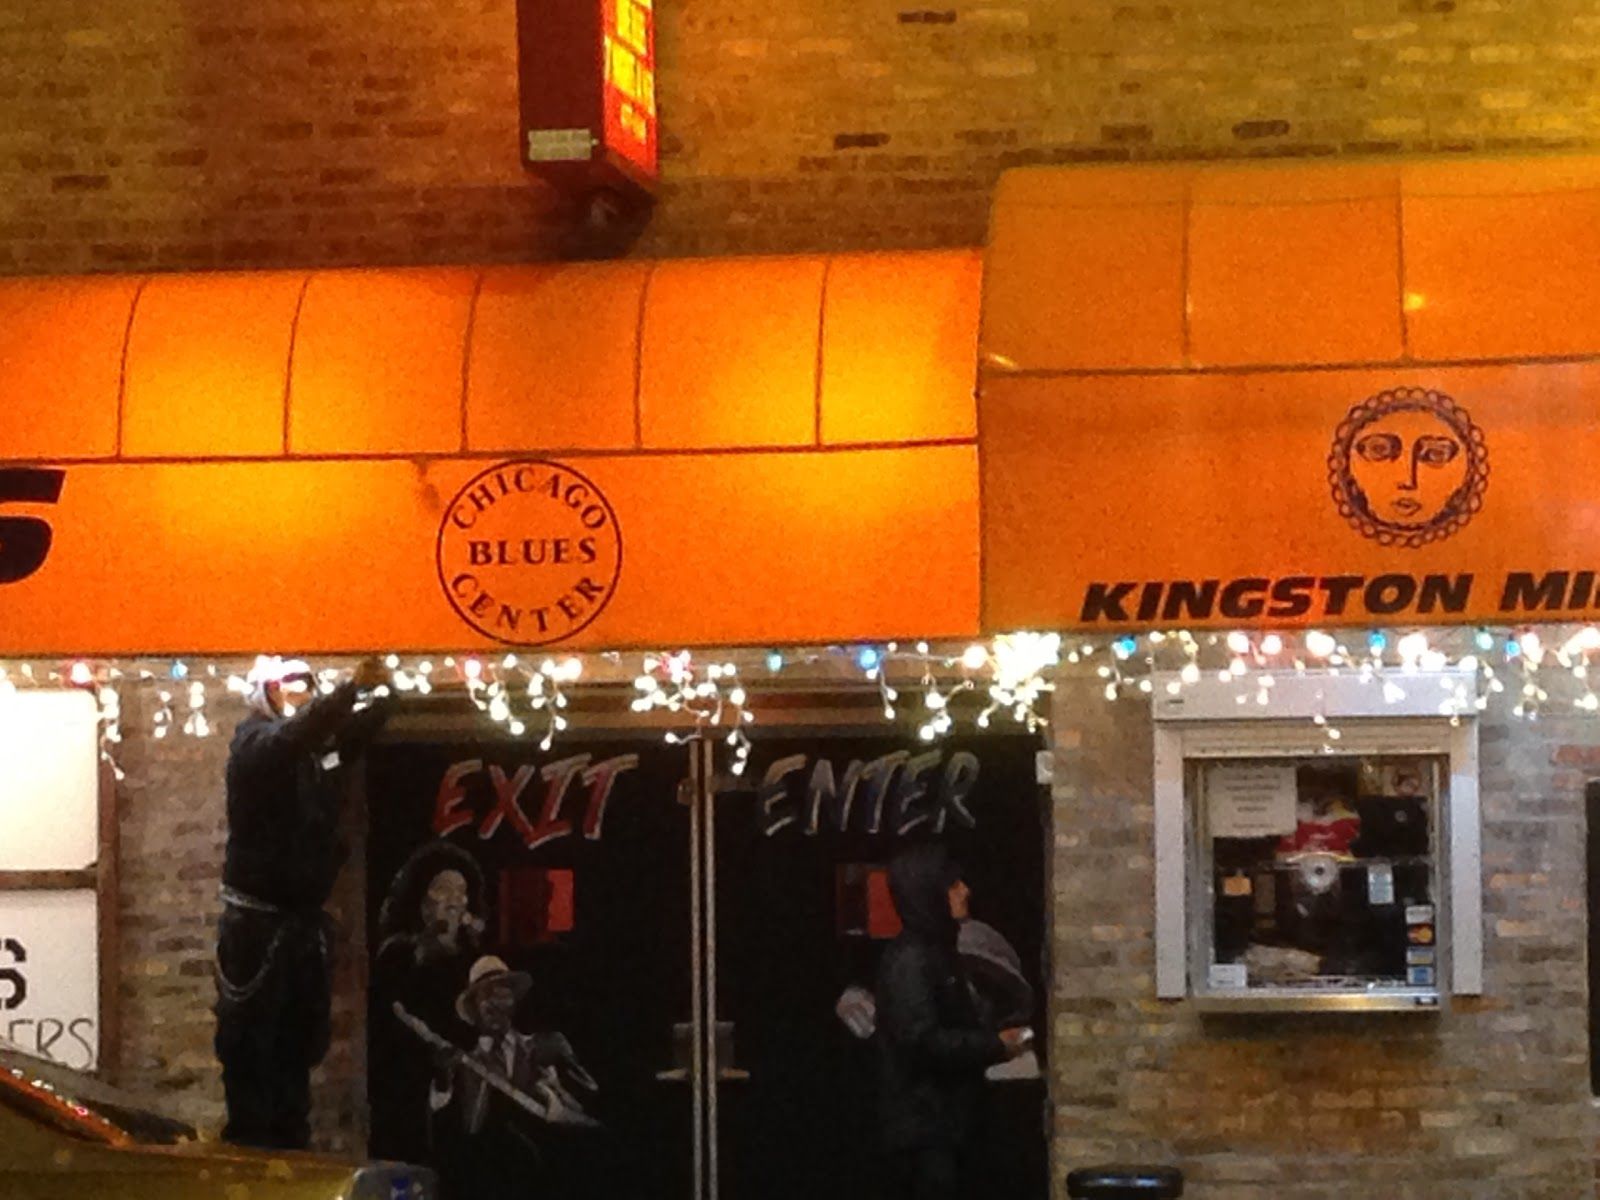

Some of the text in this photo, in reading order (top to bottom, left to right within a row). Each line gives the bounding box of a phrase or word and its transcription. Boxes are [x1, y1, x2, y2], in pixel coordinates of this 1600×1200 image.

[452, 467, 607, 530] CHICAGO
[468, 537, 597, 566] BLUES
[452, 573, 604, 632] CENTER
[1080, 569, 1600, 622] KINGSTON MI
[434, 752, 639, 849] EXIT
[758, 749, 981, 837] ENTER
